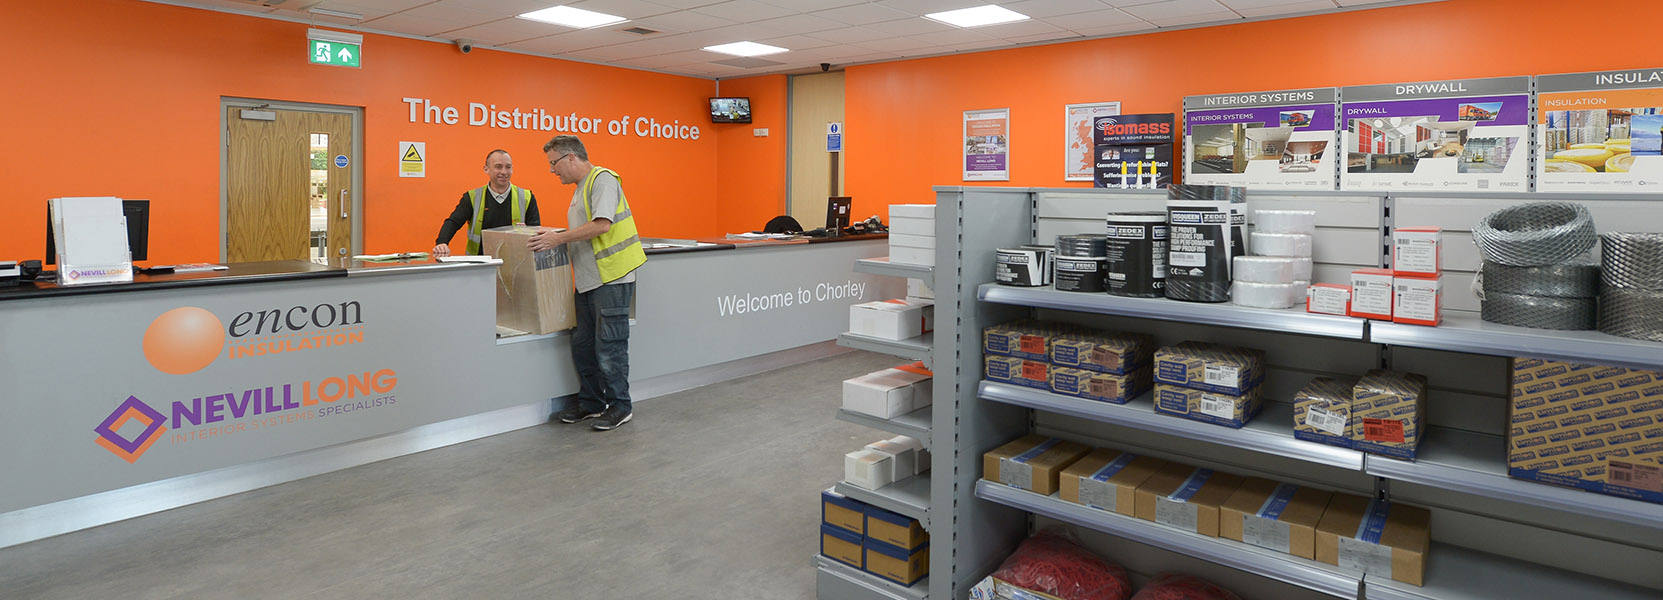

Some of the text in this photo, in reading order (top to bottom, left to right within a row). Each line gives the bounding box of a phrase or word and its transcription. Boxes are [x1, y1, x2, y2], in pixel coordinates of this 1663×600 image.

[1396, 82, 1466, 95] DRYWALL
[1595, 71, 1663, 85] INSULA
[1204, 91, 1314, 106] INTERIOR SYSTEMS
[1545, 98, 1607, 106] INSULATION
[403, 97, 700, 140] The Distributor of Choice
[1104, 122, 1170, 135] isomass
[718, 280, 866, 316] Welcome to Chorley
[228, 300, 364, 338] encon
[228, 331, 364, 359] INSULATION
[172, 368, 397, 429] NEVILL LONG
[171, 396, 396, 445] INTERIOR SYSTEMS SPECIALISTS
